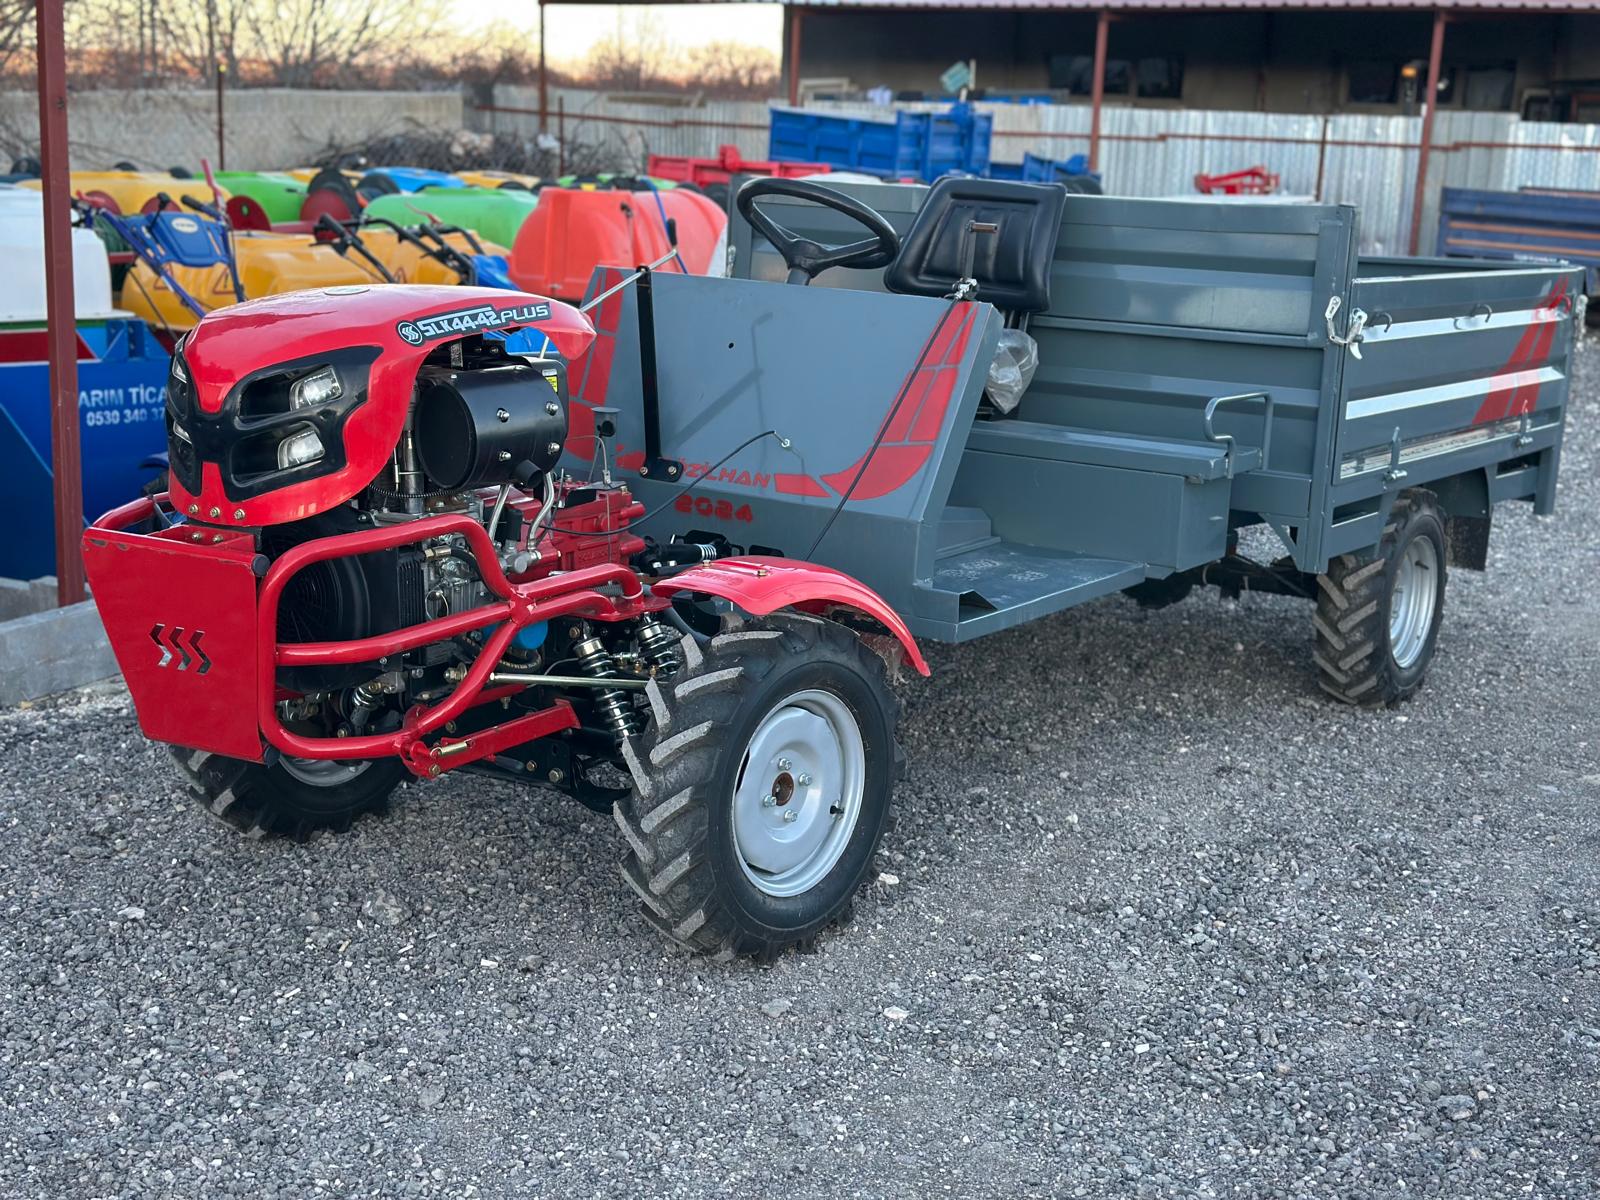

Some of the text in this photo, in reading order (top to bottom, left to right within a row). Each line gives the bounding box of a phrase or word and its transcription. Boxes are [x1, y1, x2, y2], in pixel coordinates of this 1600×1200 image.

[500, 305, 549, 323] PLUS
[86, 410, 120, 427] 0530
[674, 494, 753, 523] 2024
